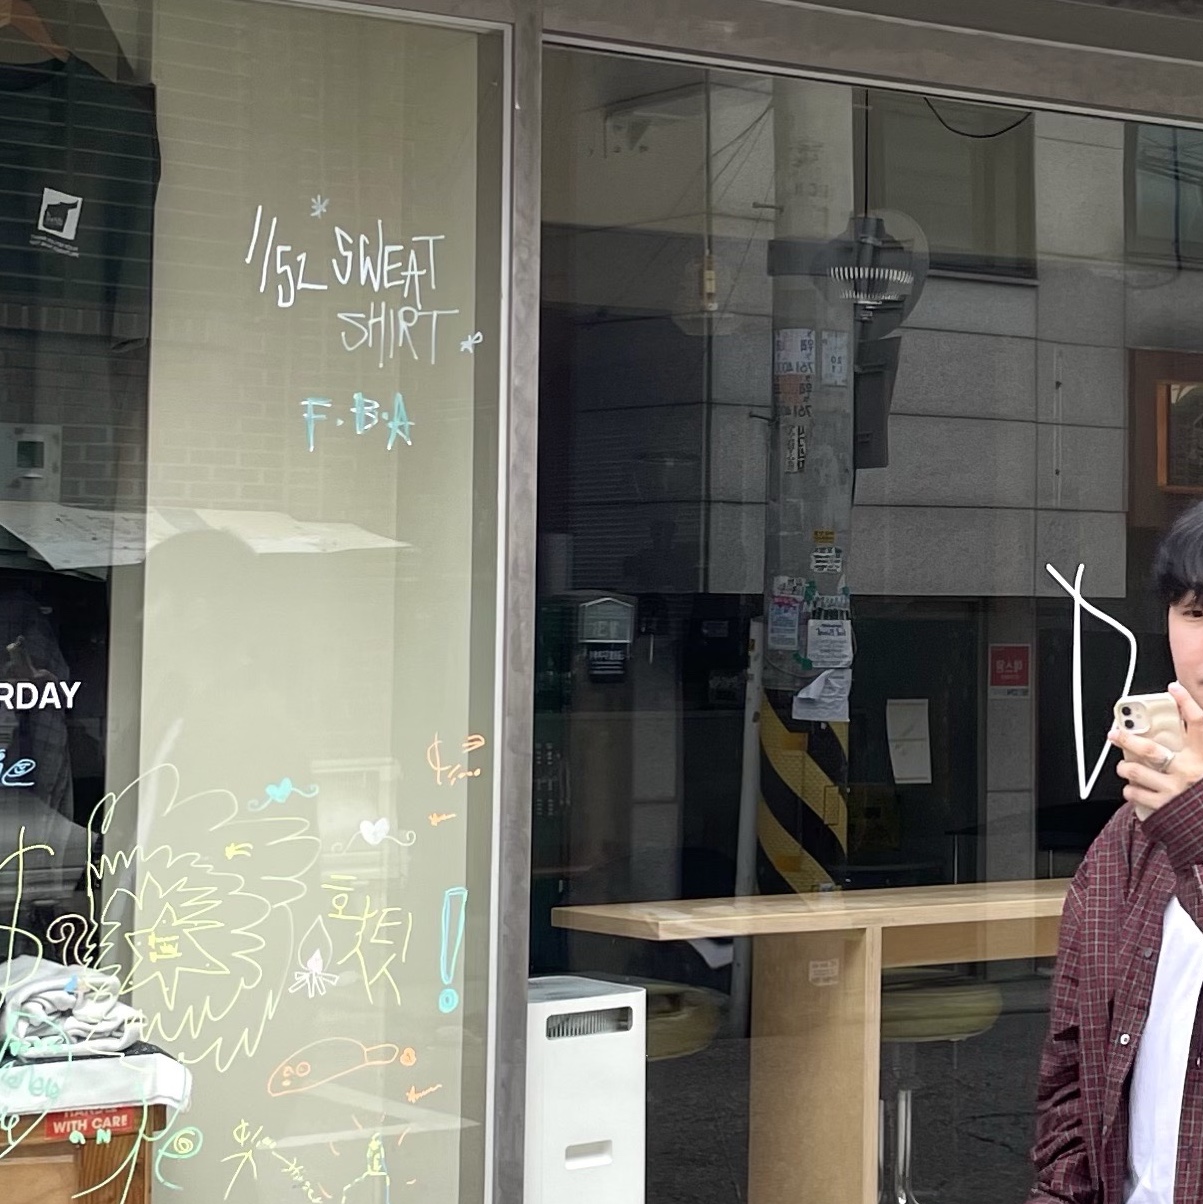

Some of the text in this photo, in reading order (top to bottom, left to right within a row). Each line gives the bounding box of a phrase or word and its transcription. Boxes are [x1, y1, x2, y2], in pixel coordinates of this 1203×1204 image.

[332, 219, 445, 310] SWEAT
[337, 301, 459, 368] SHIRT
[53, 1114, 128, 1134] WITH CARE
